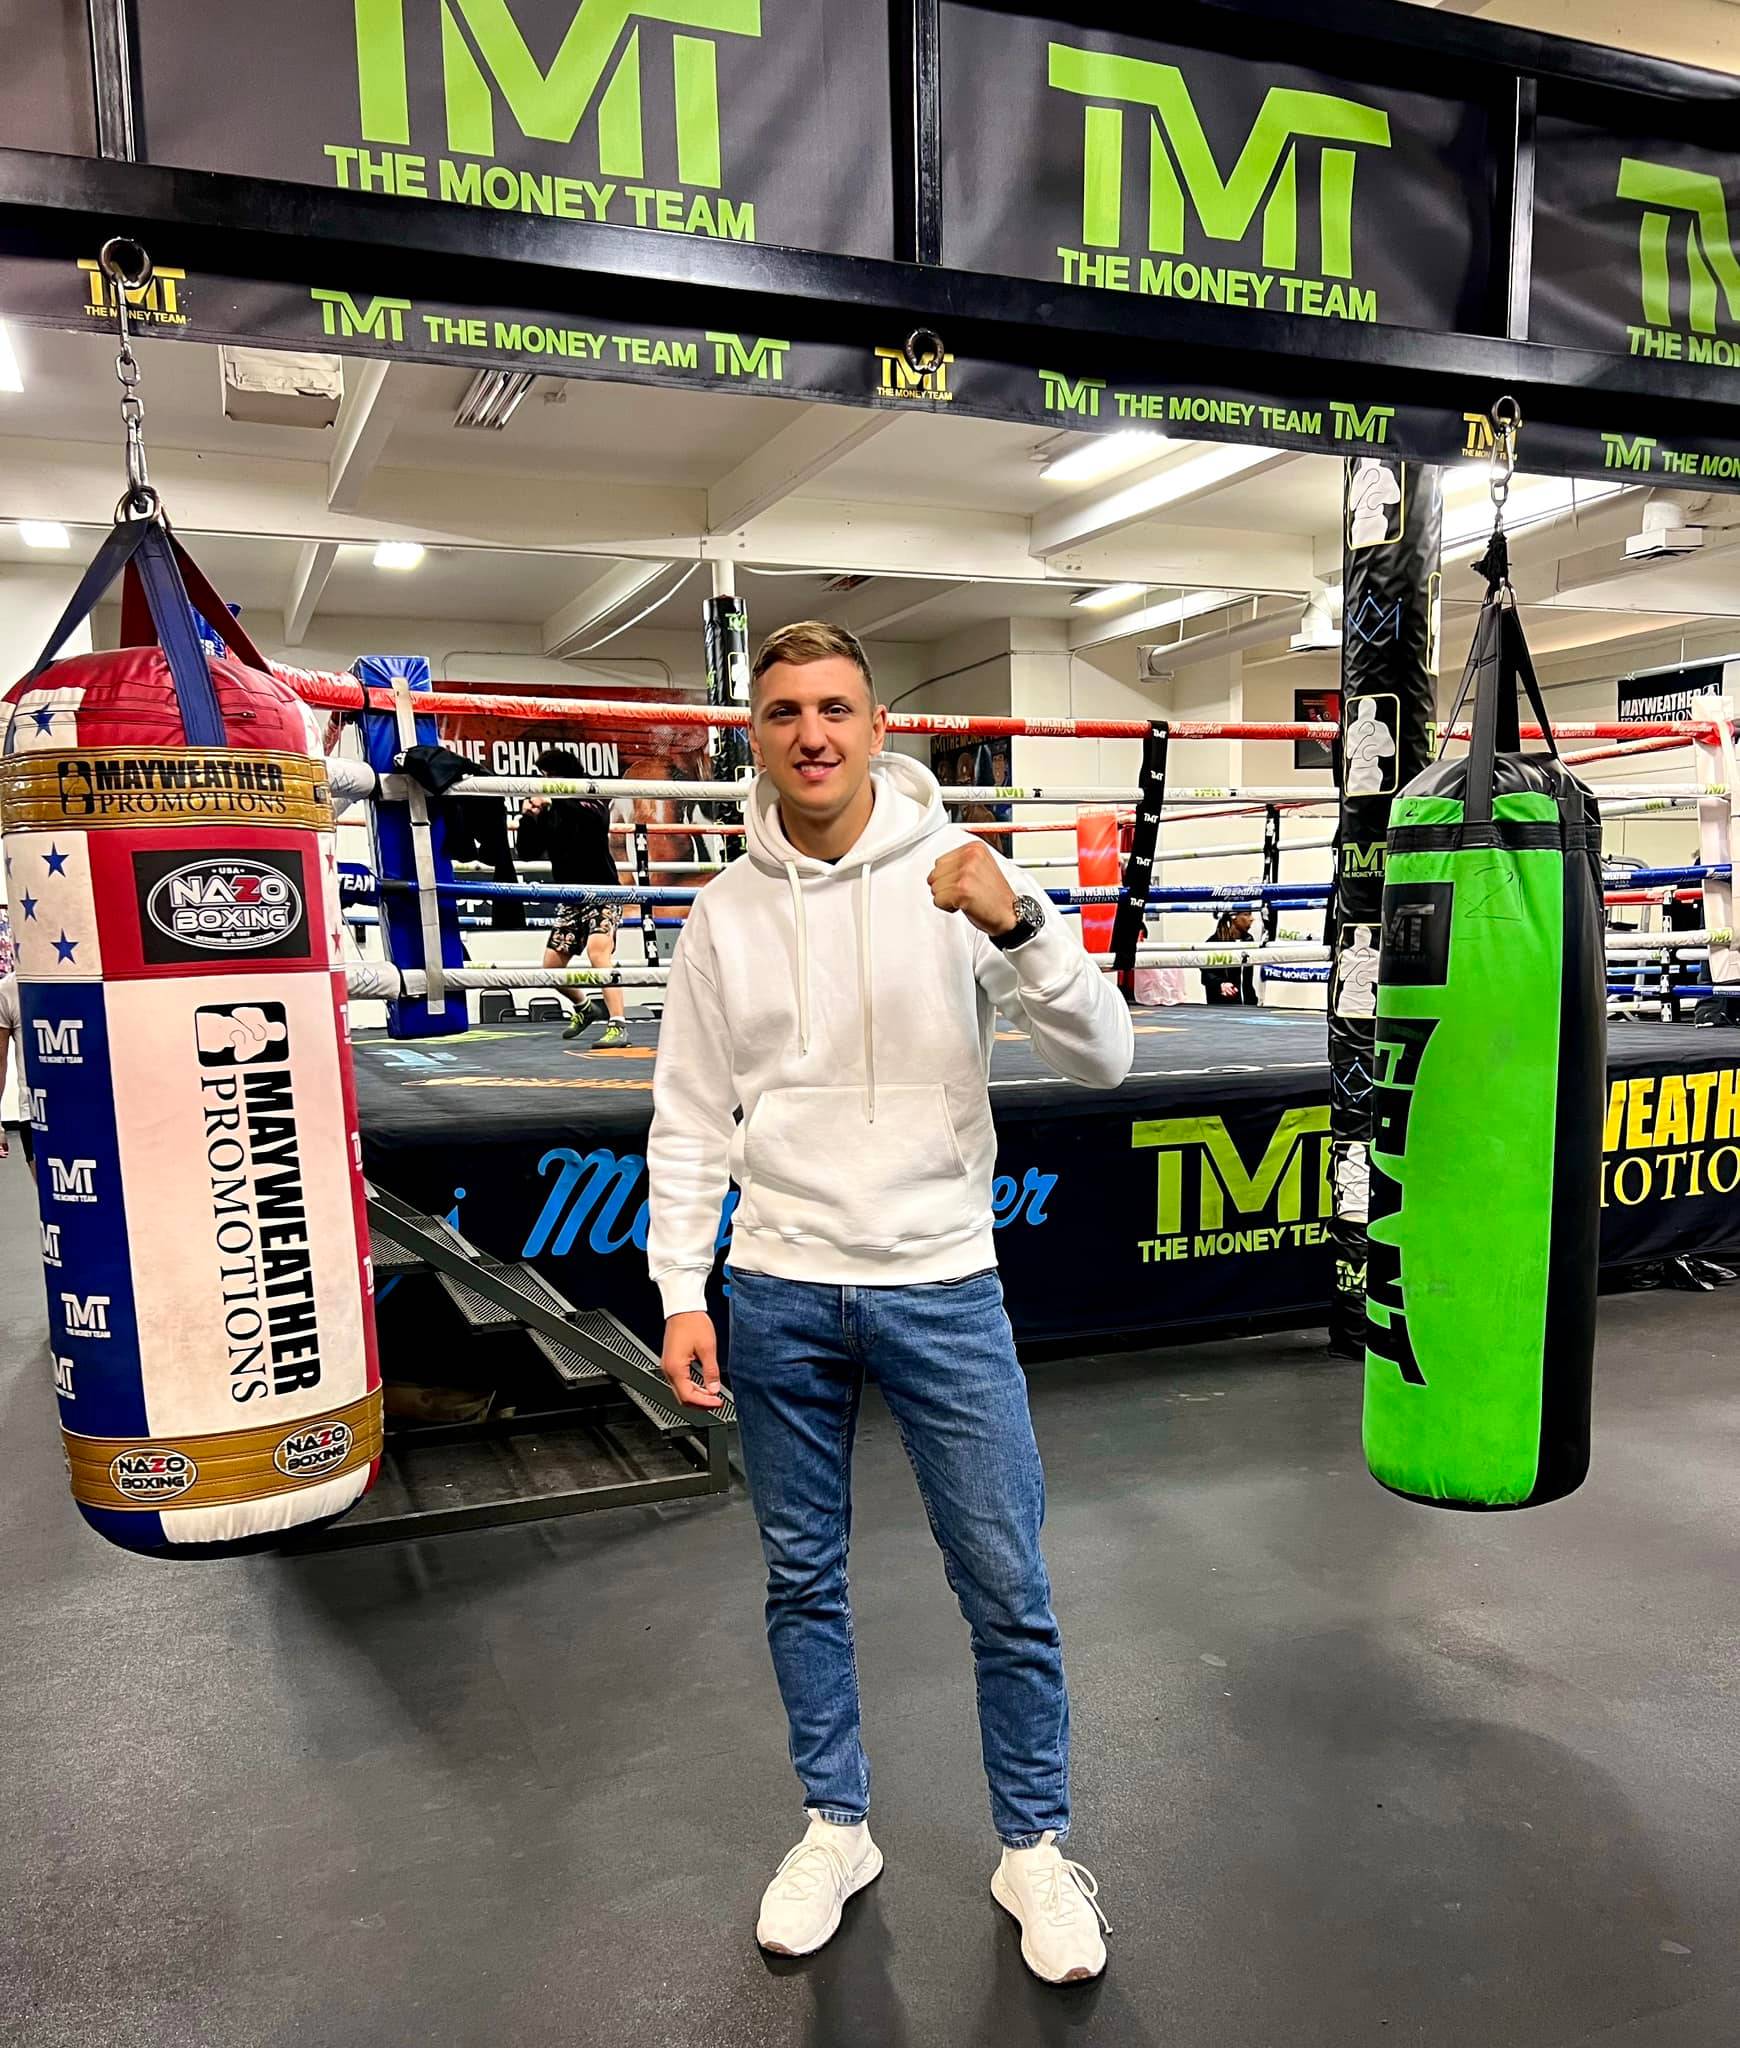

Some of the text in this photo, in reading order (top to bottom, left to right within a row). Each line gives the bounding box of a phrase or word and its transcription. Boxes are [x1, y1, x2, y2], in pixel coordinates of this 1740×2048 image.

[1049, 42, 1391, 279] TMT
[324, 145, 756, 241] THE MONEY TEAM
[1057, 247, 1377, 323] THE MONEY TEAM
[84, 305, 186, 325] THE MNEY TEAM
[311, 288, 790, 381] TMT THE MONEY TEAM TMT
[1626, 325, 1682, 360] THE
[876, 386, 953, 401] THE MONEY TEAM
[1039, 369, 1395, 443] TMT THE MONEY TEAM TMT
[1601, 433, 1657, 472] TMT
[1662, 451, 1699, 475] THE
[926, 716, 970, 729] TEAM
[94, 759, 285, 792] MAYWEATHER
[492, 741, 620, 777] CHAION
[100, 791, 287, 815] PROMOTIONS
[169, 875, 289, 908] NAZO
[173, 906, 290, 933] BOXING
[1264, 968, 1282, 978] THE
[1282, 970, 1314, 980] MONEY
[33, 1019, 83, 1054] TMT
[47, 1158, 97, 1194] TMT
[201, 1074, 268, 1403] PROMOTIONS
[243, 1069, 322, 1396] MAYWEATHER
[1137, 1237, 1188, 1262] THE
[1194, 1226, 1286, 1258] MONEY
[1336, 1259, 1367, 1288] TM
[61, 1292, 110, 1330] TMT
[285, 1425, 347, 1456] NAZO
[286, 1443, 348, 1471] BOXING
[118, 1456, 186, 1475] NAZO
[120, 1475, 187, 1490] BOXING
